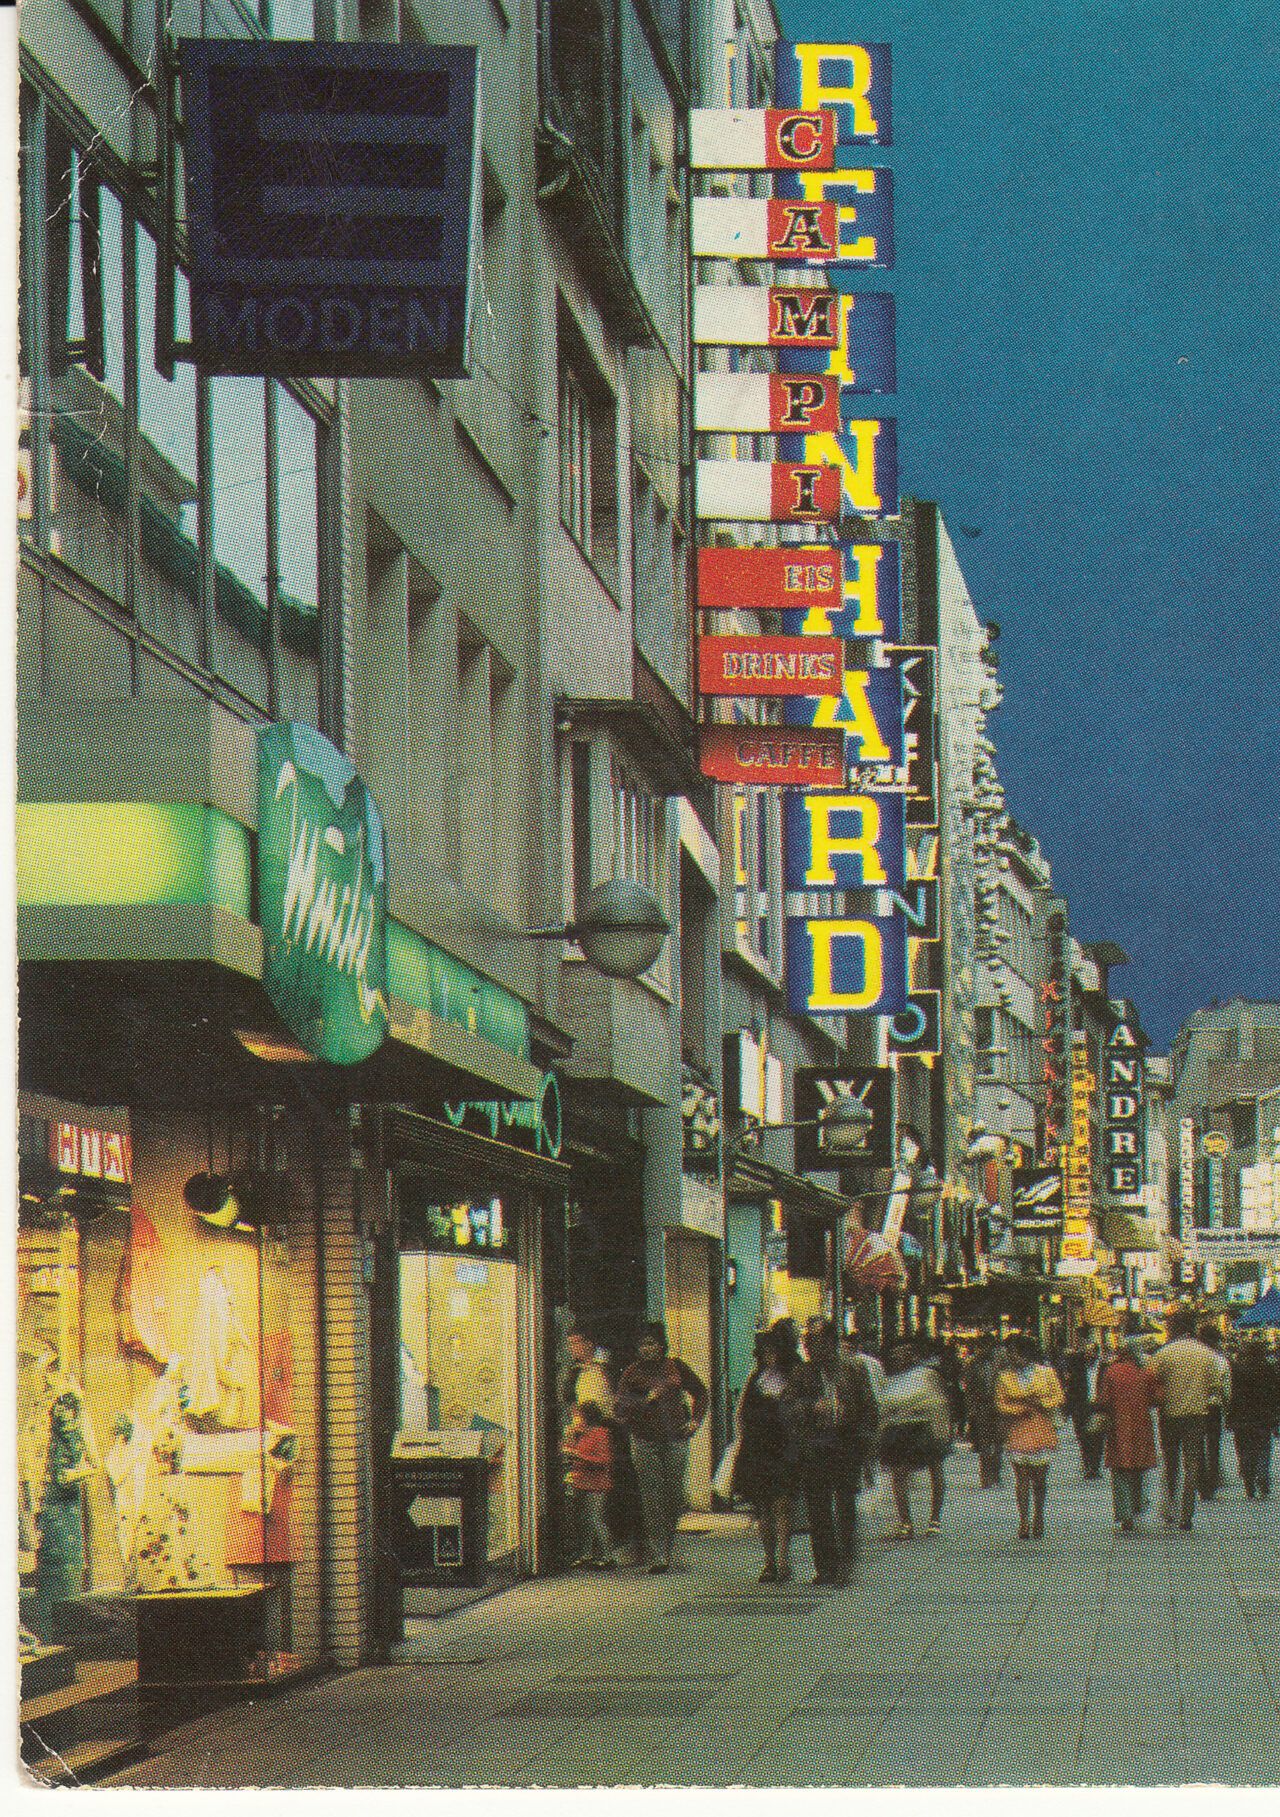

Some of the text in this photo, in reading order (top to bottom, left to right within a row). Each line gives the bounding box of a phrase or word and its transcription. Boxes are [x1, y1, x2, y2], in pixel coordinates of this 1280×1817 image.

[207, 299, 451, 353] MODEN
[772, 115, 838, 515] CAMPI
[794, 42, 890, 1011] REINHARD
[784, 565, 835, 593] EIS
[722, 651, 836, 681] DRINKS
